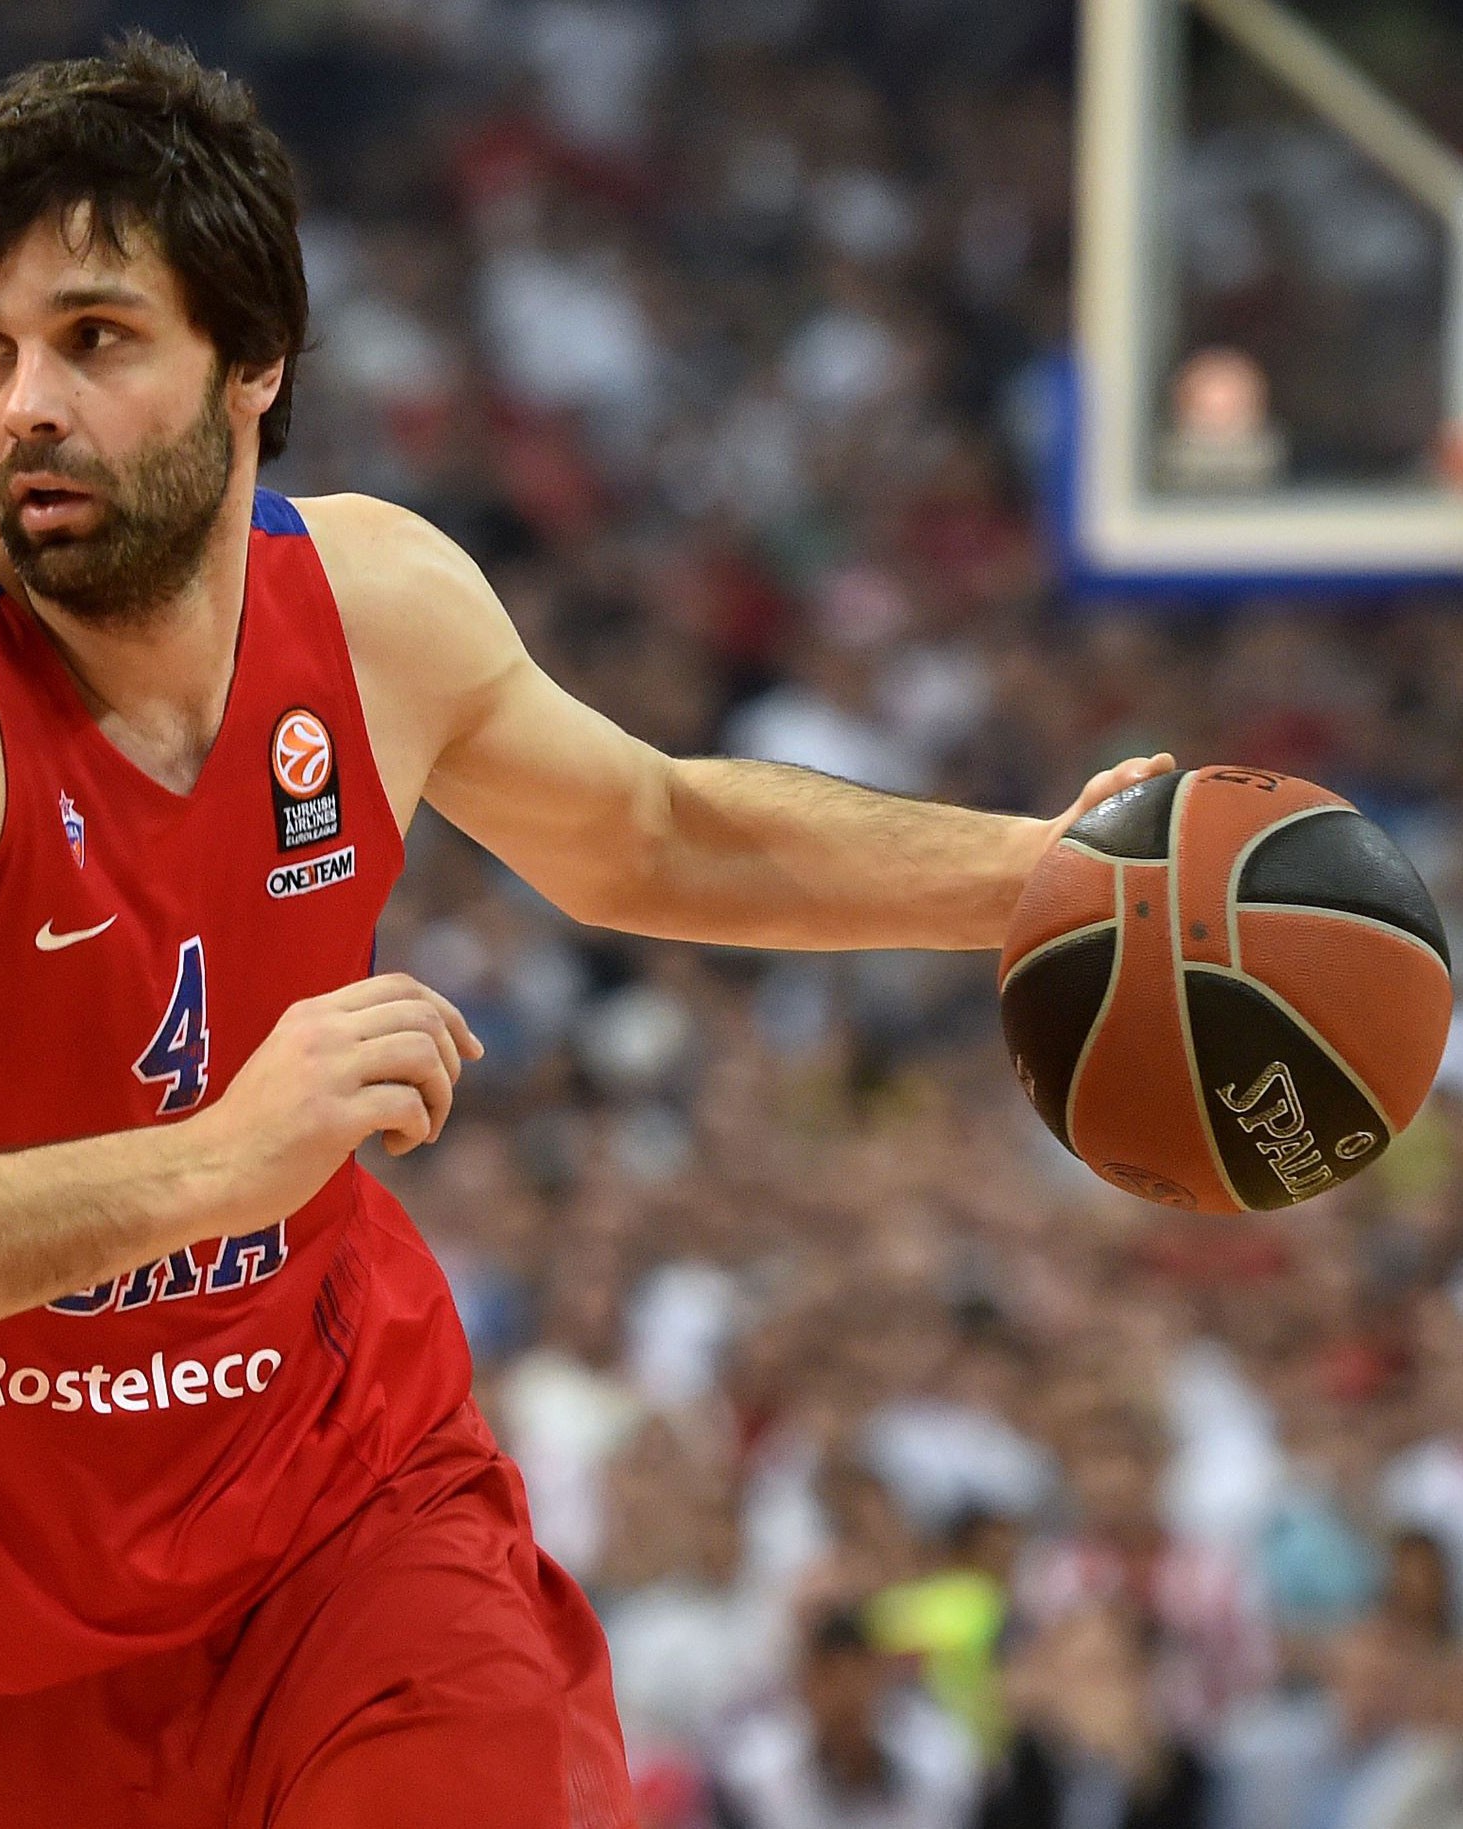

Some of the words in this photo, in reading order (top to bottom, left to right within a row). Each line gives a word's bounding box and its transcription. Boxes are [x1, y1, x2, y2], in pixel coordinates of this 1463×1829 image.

[283, 792, 336, 821] TURKISH
[285, 808, 337, 836] AIRLINES
[130, 934, 210, 1117] 4
